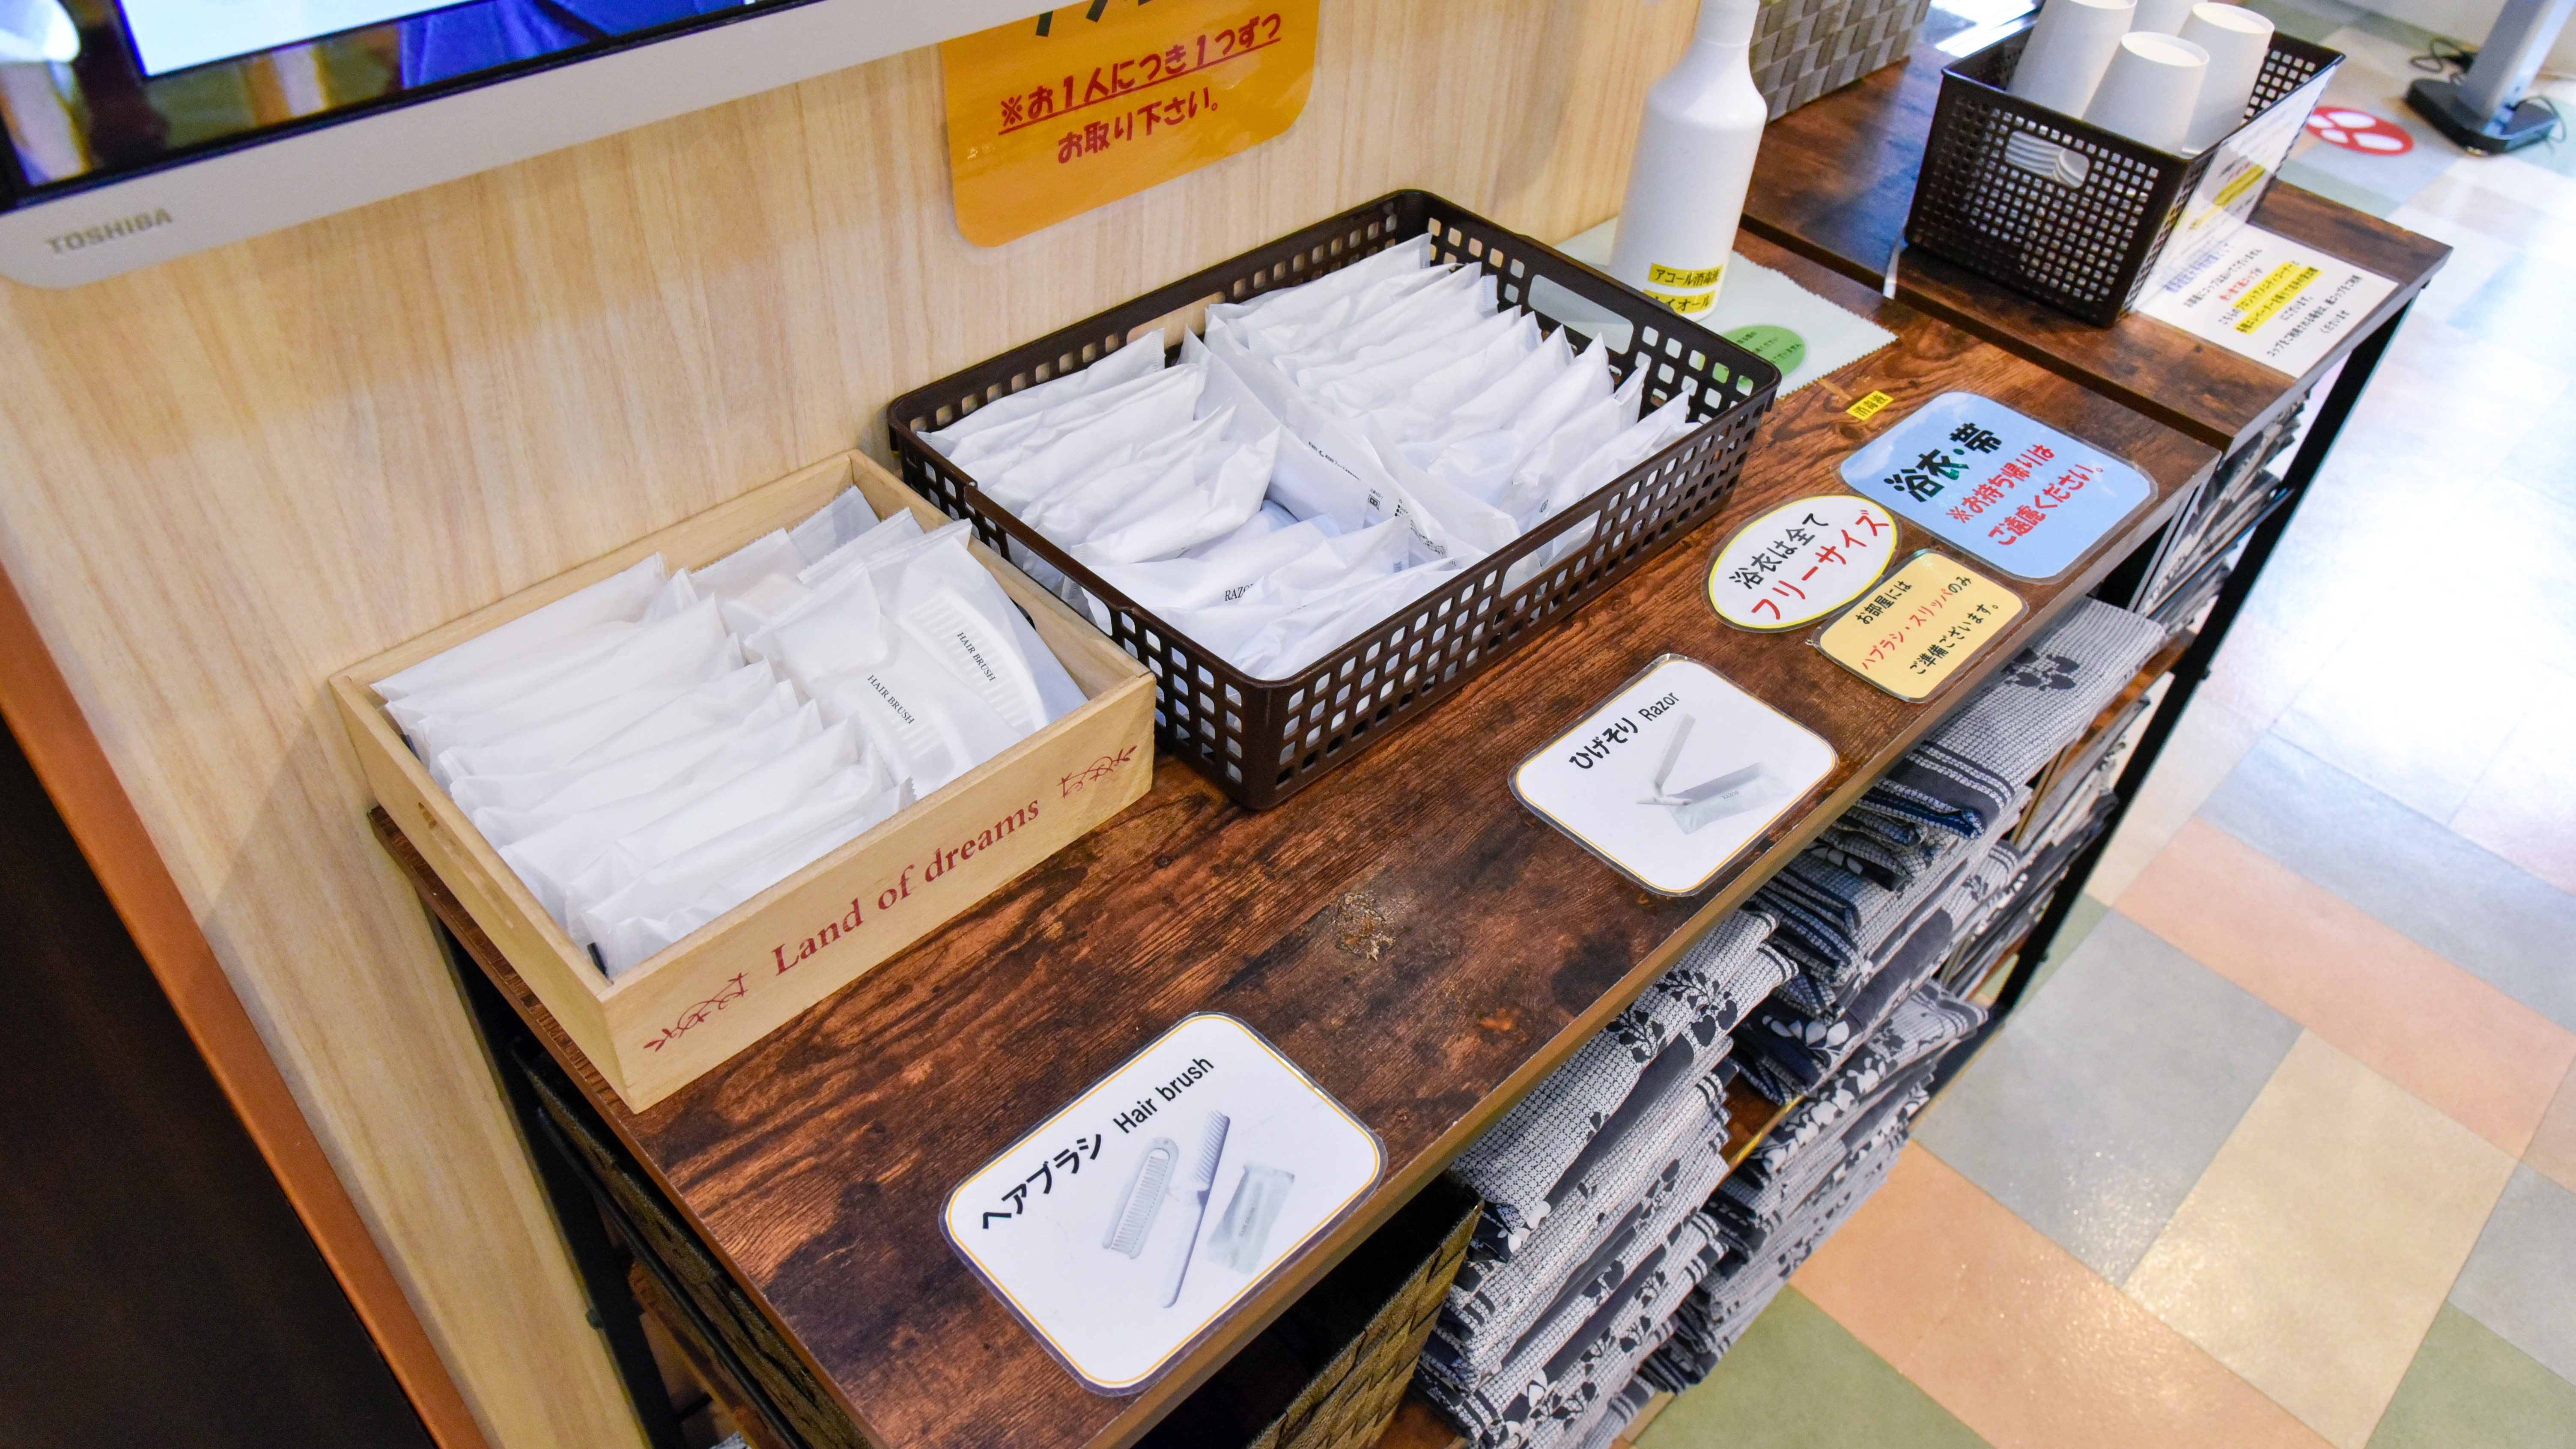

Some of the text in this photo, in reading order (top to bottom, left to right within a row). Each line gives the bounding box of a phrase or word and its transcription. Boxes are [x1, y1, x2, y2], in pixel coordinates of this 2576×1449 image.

[1058, 87, 1218, 164] お取り下さい。
[45, 208, 173, 254] TOSHIBA
[1884, 422, 2003, 502] 浴衣・帯
[1988, 464, 2104, 546] ご遠慮ください。
[1729, 513, 1829, 589] 浴衣は全て
[1751, 510, 1889, 620] フリーサイズ
[1225, 583, 1254, 601] RAZO
[1855, 581, 1912, 624] お部屋には
[957, 632, 996, 682] HAIR BRUSH
[1910, 604, 1999, 674] ご準備ございます。
[867, 674, 915, 725] HAIR BRUSH
[1568, 692, 1680, 769] ひげそり Razor
[771, 799, 1040, 976] Land of dreams
[983, 1057, 1214, 1229] ヘアブラシ Hair brush
